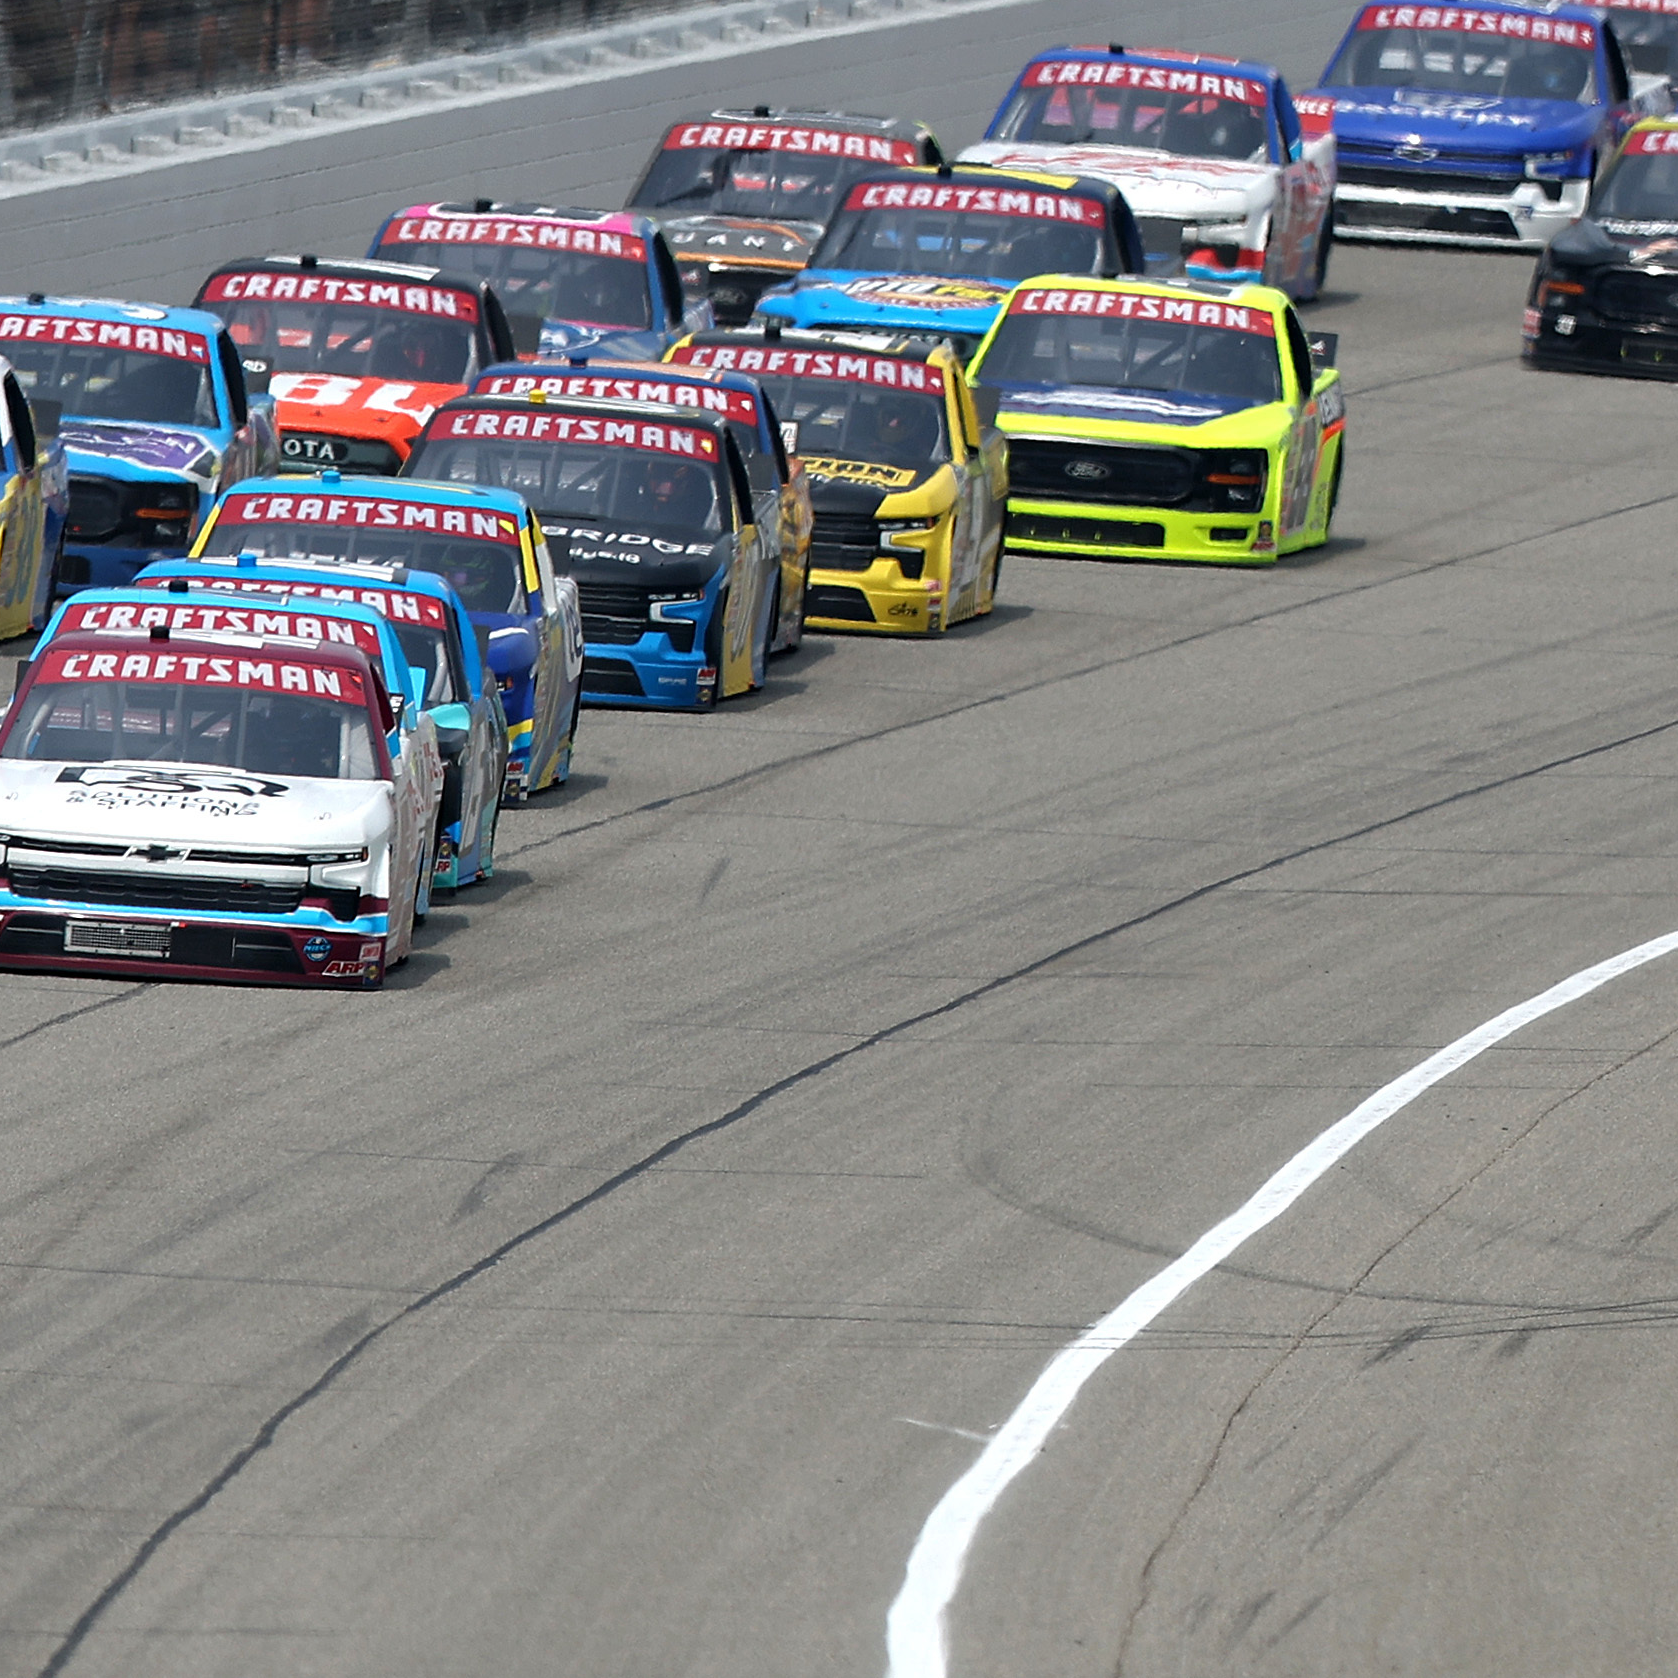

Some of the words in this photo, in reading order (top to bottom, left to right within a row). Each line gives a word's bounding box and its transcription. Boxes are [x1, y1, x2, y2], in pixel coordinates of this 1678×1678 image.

[1376, 6, 1578, 43] CRAFTSMAN
[1037, 63, 1247, 101] CRAFTSMAN
[678, 125, 893, 161] CRAFTSMAN
[861, 185, 1085, 221] CRAFTSMAN
[398, 220, 622, 255] CRAFTSMAN
[222, 275, 457, 317] CRAFTSMAN
[1022, 291, 1251, 330] CRAFTSMAN
[690, 348, 924, 389] CRAFTSMAN
[489, 378, 729, 411] CRAFTSMAN
[284, 439, 335, 460] OTA
[452, 413, 694, 454] CRAFTSMAN
[242, 497, 506, 539] CRAFTSMAN
[80, 604, 357, 646] CRAFTSMAN
[61, 653, 342, 696] CRAFTSMAN
[325, 962, 365, 974] ARP
